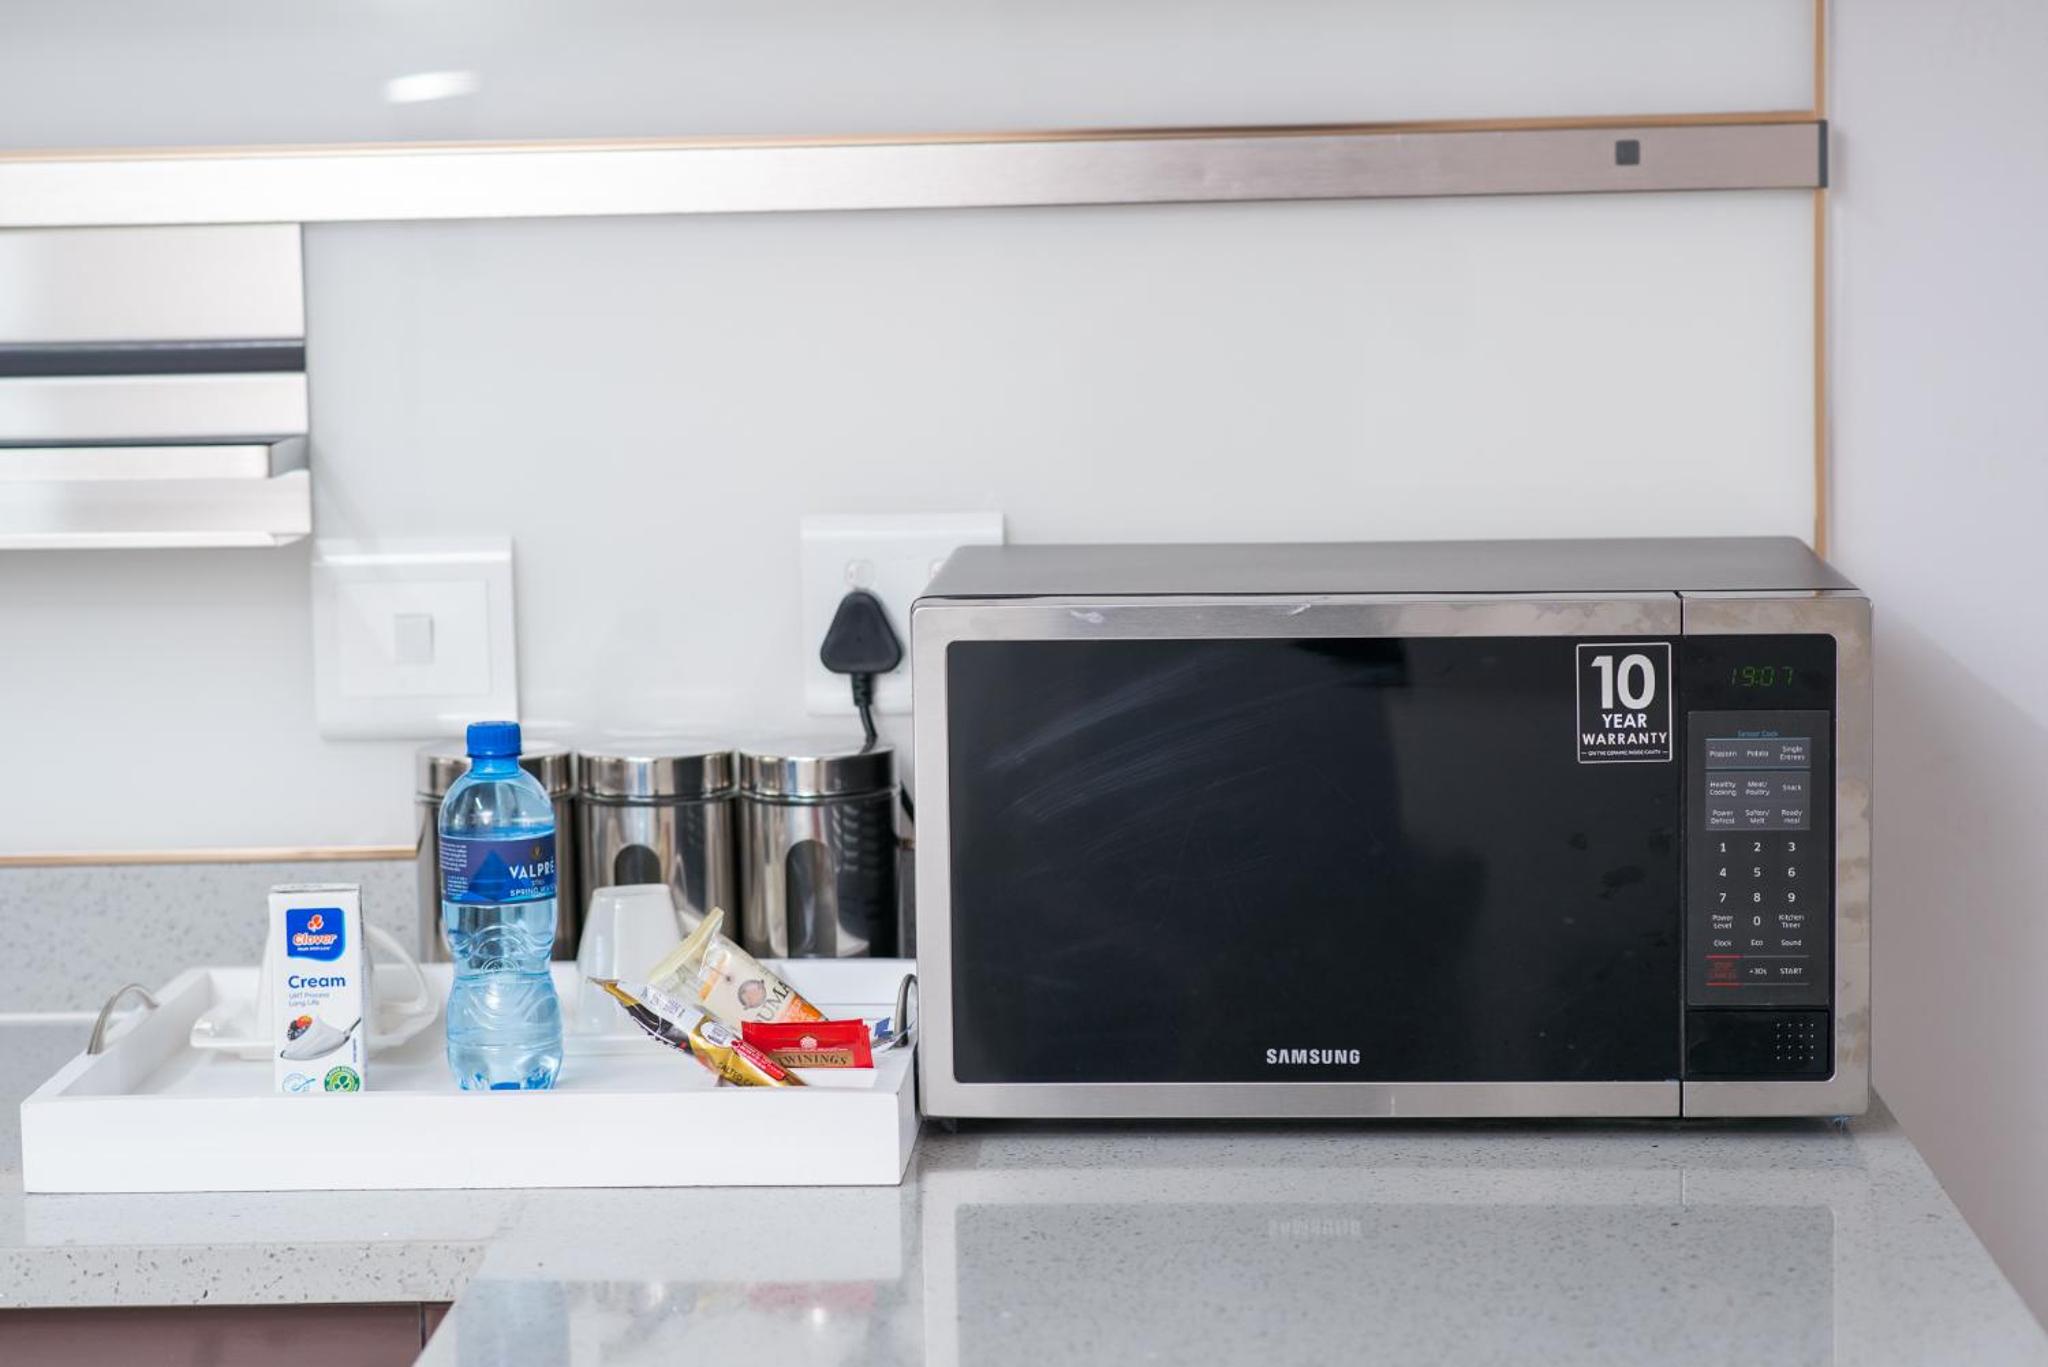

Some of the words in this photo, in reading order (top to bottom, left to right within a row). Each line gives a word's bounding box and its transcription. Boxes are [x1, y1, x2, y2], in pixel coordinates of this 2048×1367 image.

[1591, 653, 1656, 710] 10
[1602, 713, 1647, 729] YEAR
[1582, 732, 1668, 745] WARRANTY
[1710, 781, 1736, 789] Healthy
[1709, 789, 1737, 797] Cooking
[1745, 789, 1770, 797] Poultry
[1712, 809, 1734, 817] Power
[1781, 809, 1803, 818] Ready
[1720, 843, 1726, 852] 1
[1753, 843, 1761, 852] 2
[1788, 843, 1796, 852] 3
[1719, 868, 1727, 877] 4
[1753, 868, 1761, 877] 5
[1788, 868, 1796, 877] 6
[1719, 893, 1727, 902] 7
[1753, 893, 1761, 902] 8
[1787, 893, 1796, 902] 9
[1712, 914, 1733, 922] Power
[1753, 916, 1761, 926] 0
[1778, 914, 1804, 922] Kitchen
[293, 932, 337, 946] Clover
[1713, 939, 1733, 947] Clock
[1781, 939, 1802, 947] Sound
[1780, 967, 1803, 975] START
[288, 975, 346, 989] Cream
[1266, 1048, 1361, 1065] SAMSUNG
